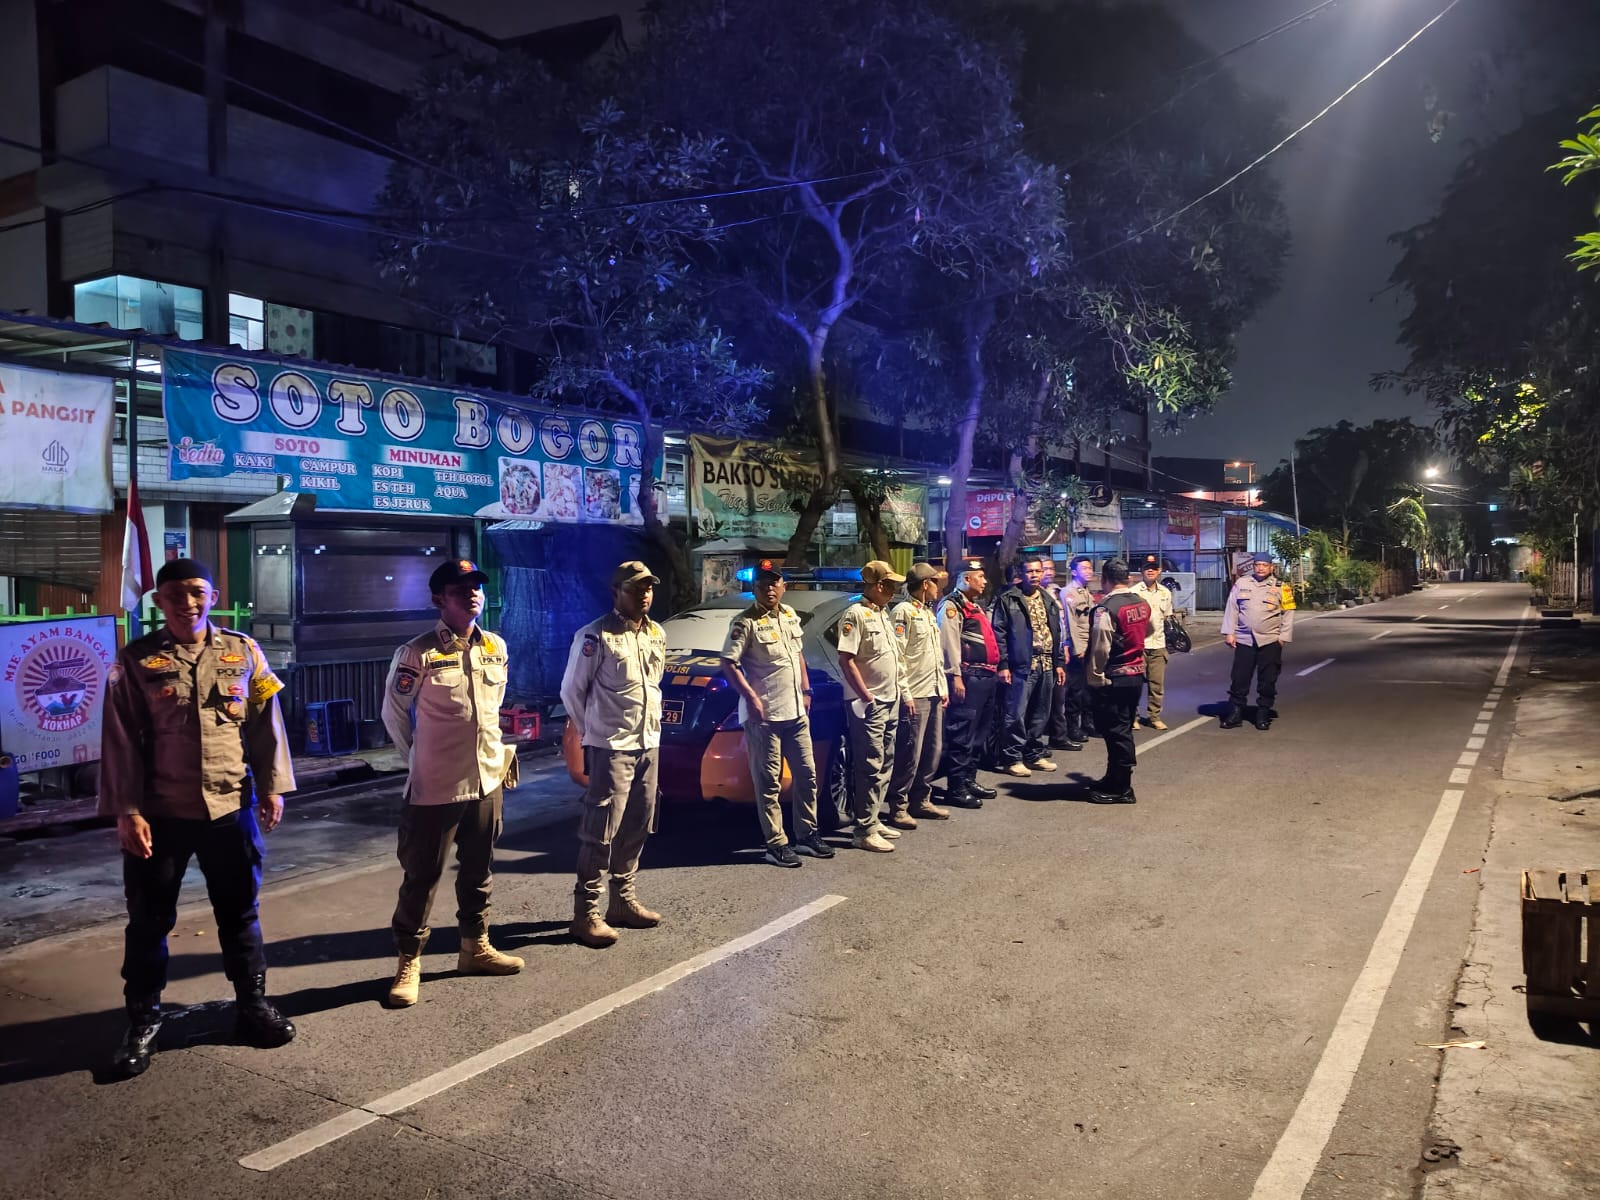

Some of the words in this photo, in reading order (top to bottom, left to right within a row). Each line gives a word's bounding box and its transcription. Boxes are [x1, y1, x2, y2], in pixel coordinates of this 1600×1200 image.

[12, 400, 96, 424] PANGSIT
[212, 363, 426, 442] SOTO
[453, 396, 644, 469] BOGOR
[178, 437, 225, 464] Sedia
[274, 438, 321, 454] SOTO
[233, 453, 274, 468] KAKI
[389, 448, 461, 467] MINUMAN
[300, 459, 357, 474] CAMPUR
[372, 465, 404, 479] KOPI
[434, 471, 457, 483] TEH
[458, 473, 494, 486] BOTOL
[703, 461, 765, 488] BAKSO
[300, 476, 340, 490] KIKIL
[373, 481, 389, 493] ES
[391, 482, 415, 495] TEH
[434, 485, 468, 498] AQUA
[373, 496, 390, 508] ES
[391, 497, 432, 511] JERUK
[1126, 606, 1148, 624] POLIS
[4, 654, 22, 682] MIE
[20, 627, 60, 654] AYAM
[42, 714, 83, 731] KOKHAP
[35, 748, 61, 761] FOOD
